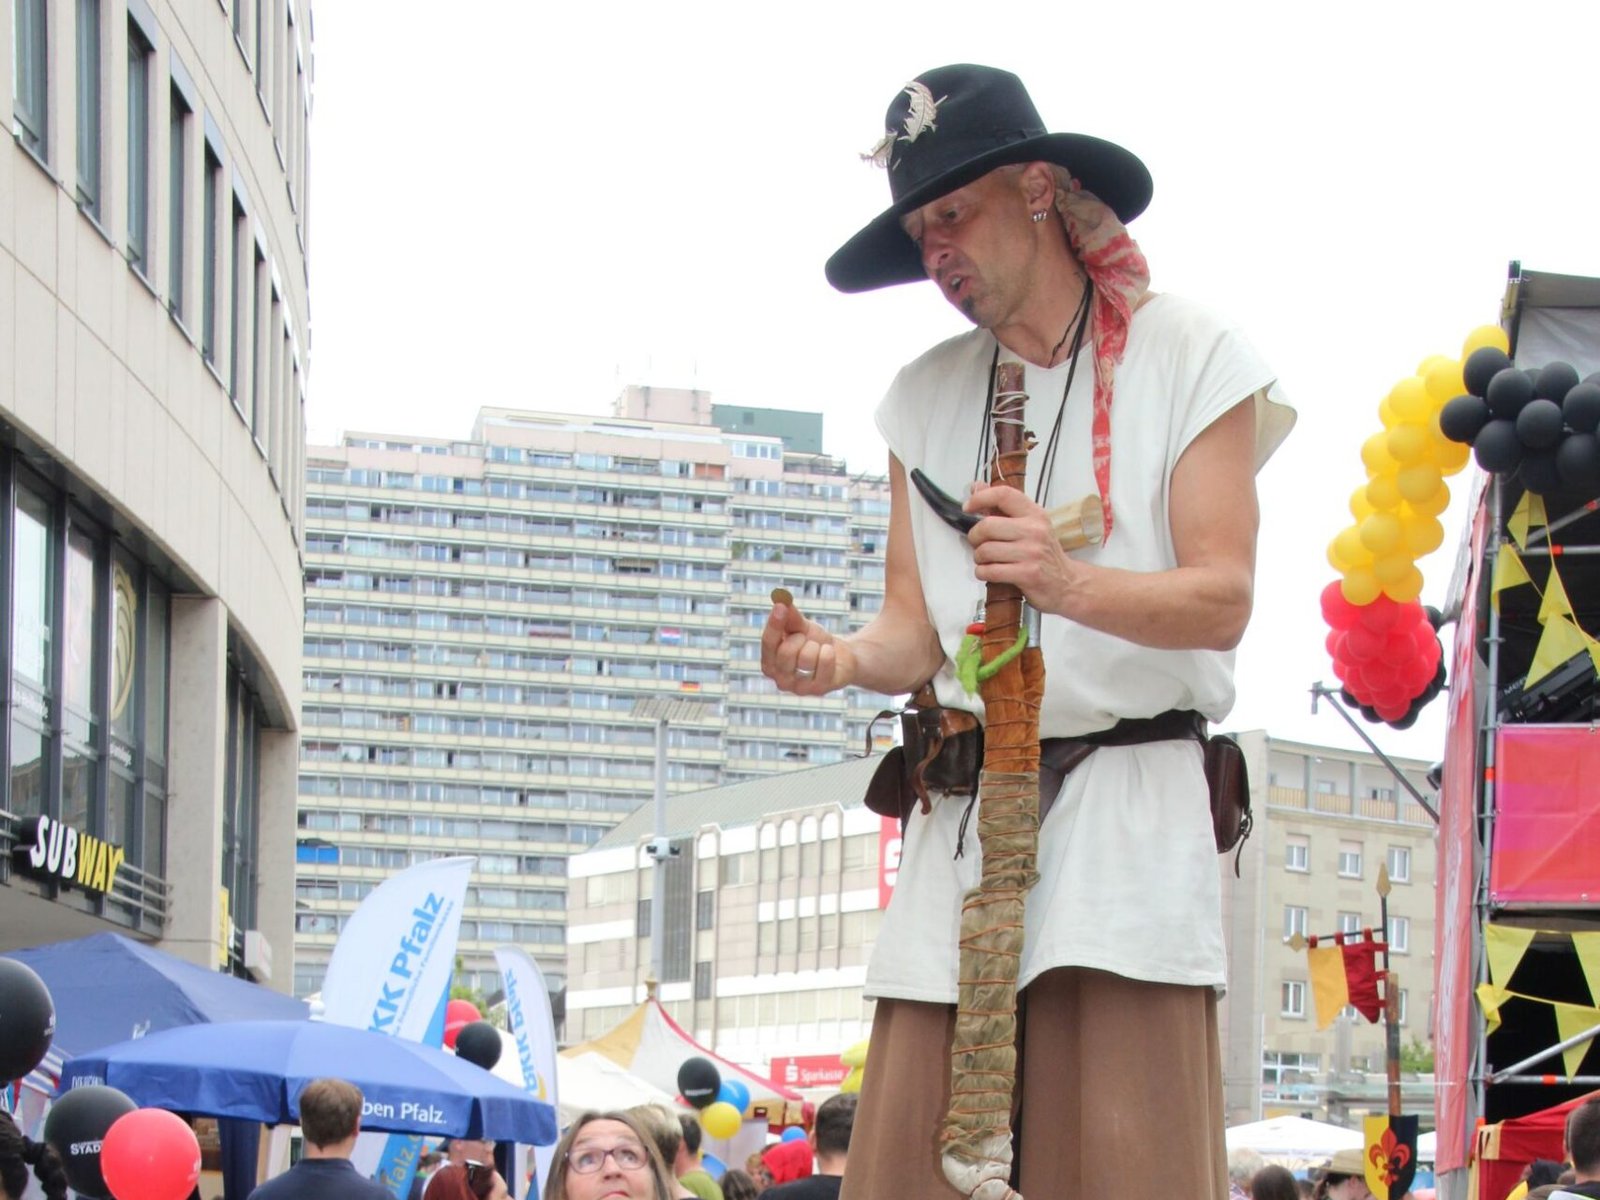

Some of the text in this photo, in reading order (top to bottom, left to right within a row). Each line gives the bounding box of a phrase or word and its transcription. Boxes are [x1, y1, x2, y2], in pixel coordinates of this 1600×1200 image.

[30, 814, 125, 896] SUBWAY
[390, 892, 444, 979] Pfalz
[401, 1101, 447, 1124] Pfalz.
